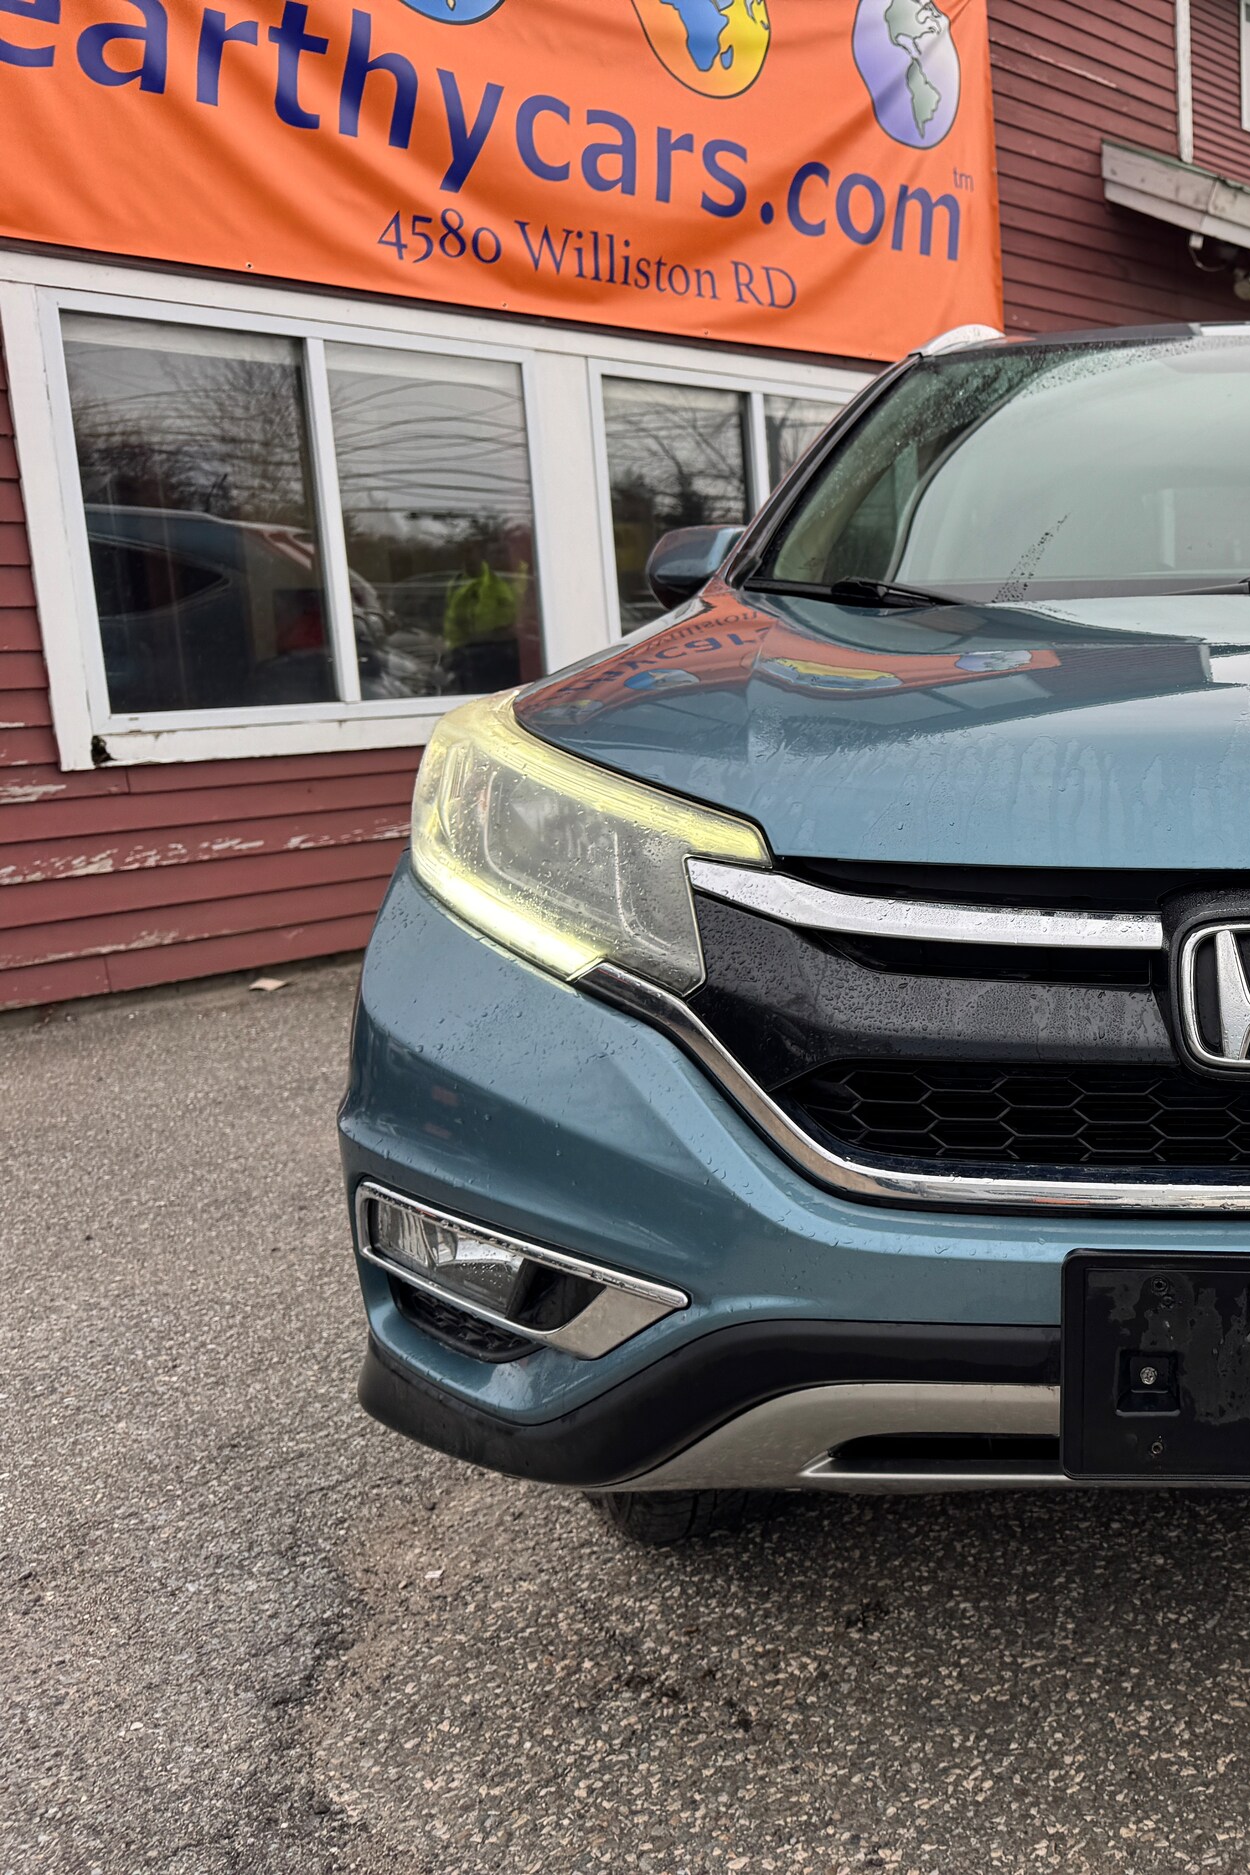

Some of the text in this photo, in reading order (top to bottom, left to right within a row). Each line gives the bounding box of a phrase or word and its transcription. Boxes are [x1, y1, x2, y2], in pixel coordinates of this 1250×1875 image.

[377, 208, 797, 309] 4580 Williston RD
